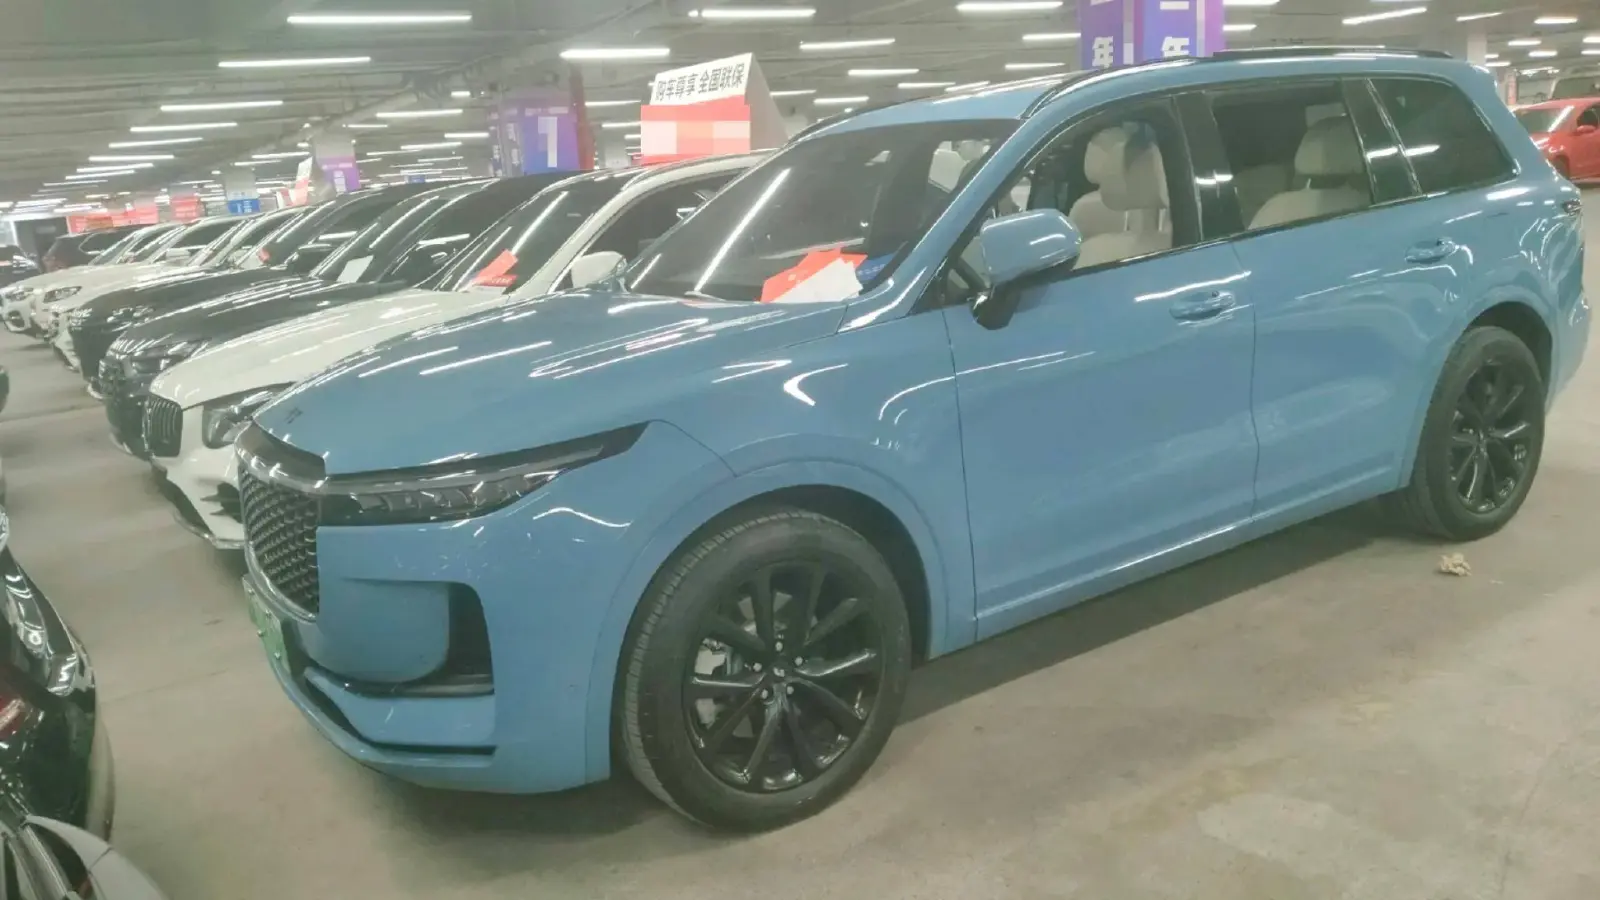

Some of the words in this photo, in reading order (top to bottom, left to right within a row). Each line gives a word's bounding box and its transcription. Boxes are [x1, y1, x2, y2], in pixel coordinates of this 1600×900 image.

[655, 73, 698, 101] 购车尊享
[698, 63, 745, 94] 全国联保
